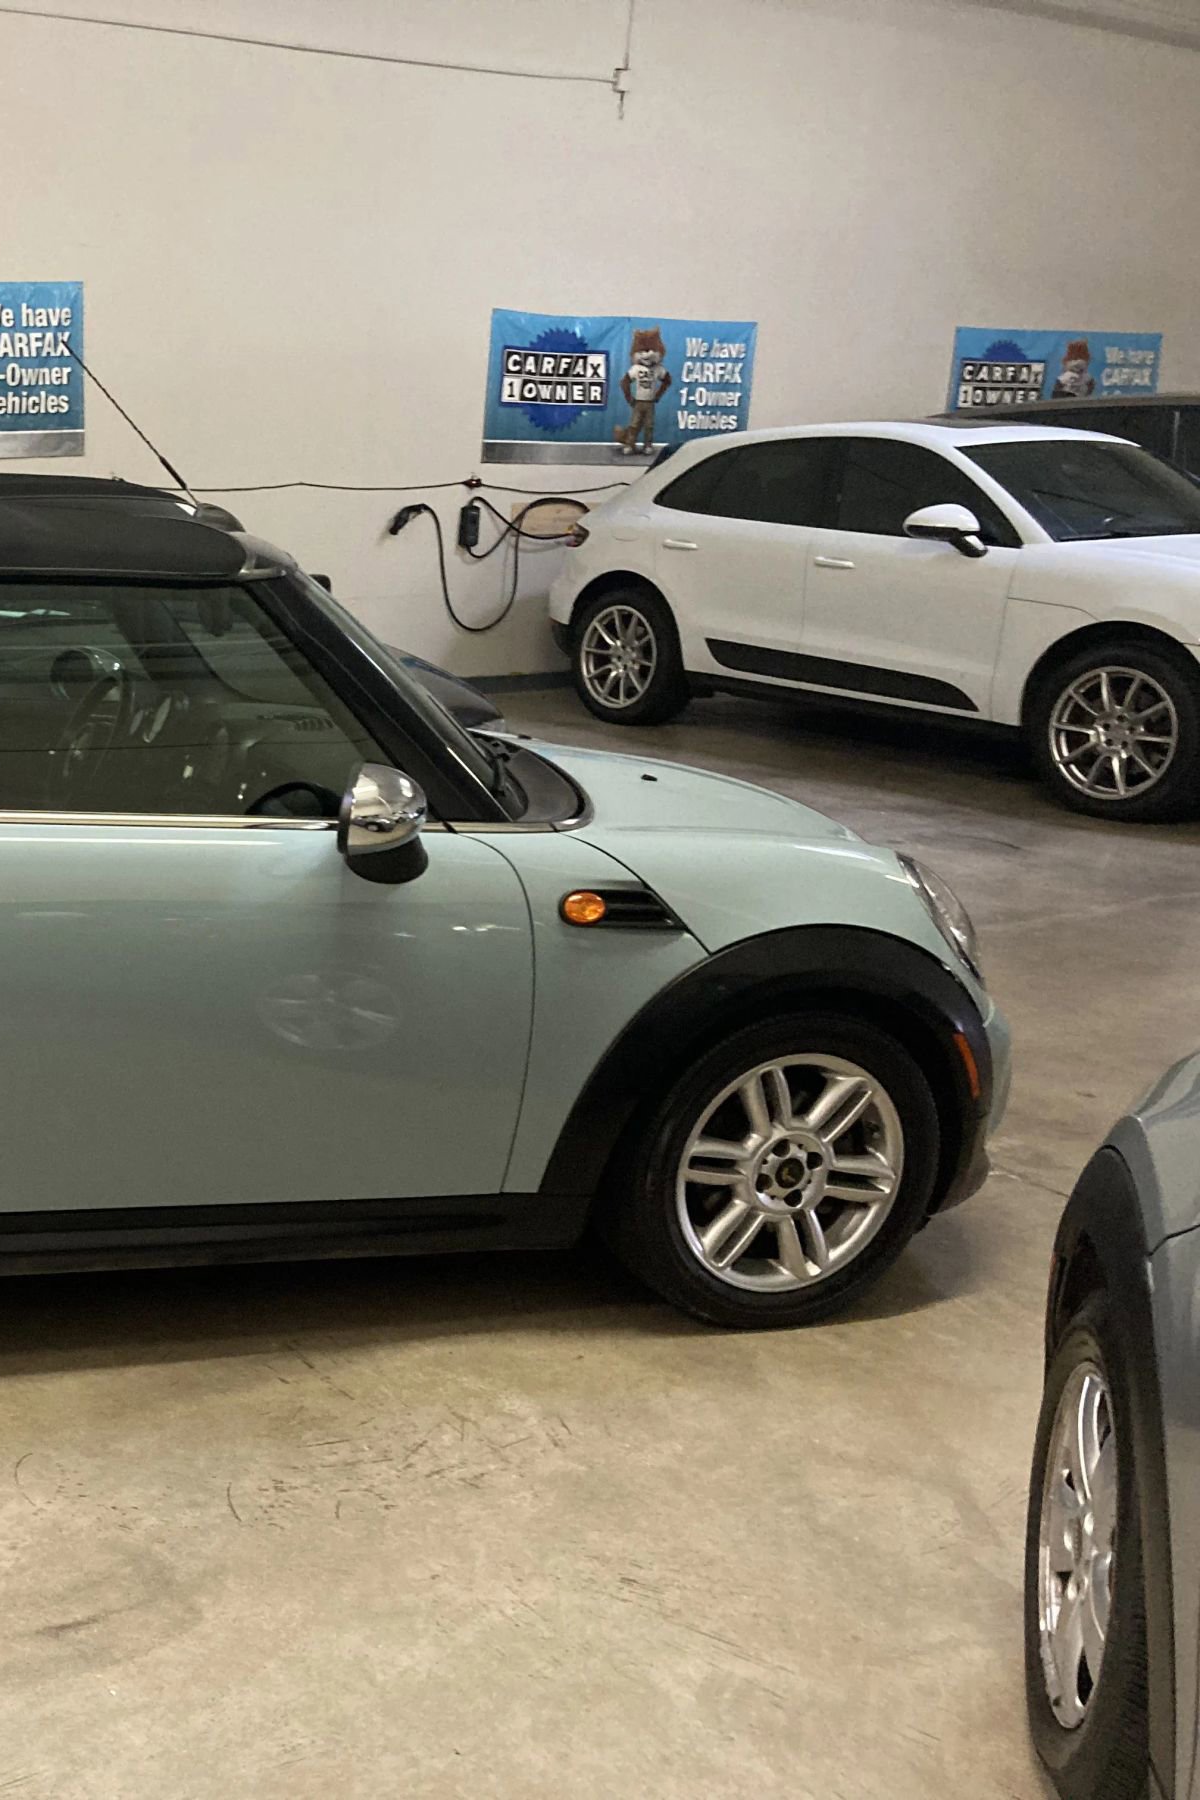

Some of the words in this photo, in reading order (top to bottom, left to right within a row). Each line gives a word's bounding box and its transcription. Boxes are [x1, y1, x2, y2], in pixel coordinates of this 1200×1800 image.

[21, 303, 72, 327] have
[686, 337, 709, 358] We
[710, 339, 746, 358] have
[506, 356, 603, 378] CARFAX
[681, 361, 743, 383] CARFAX
[677, 410, 737, 430] Vehicles
